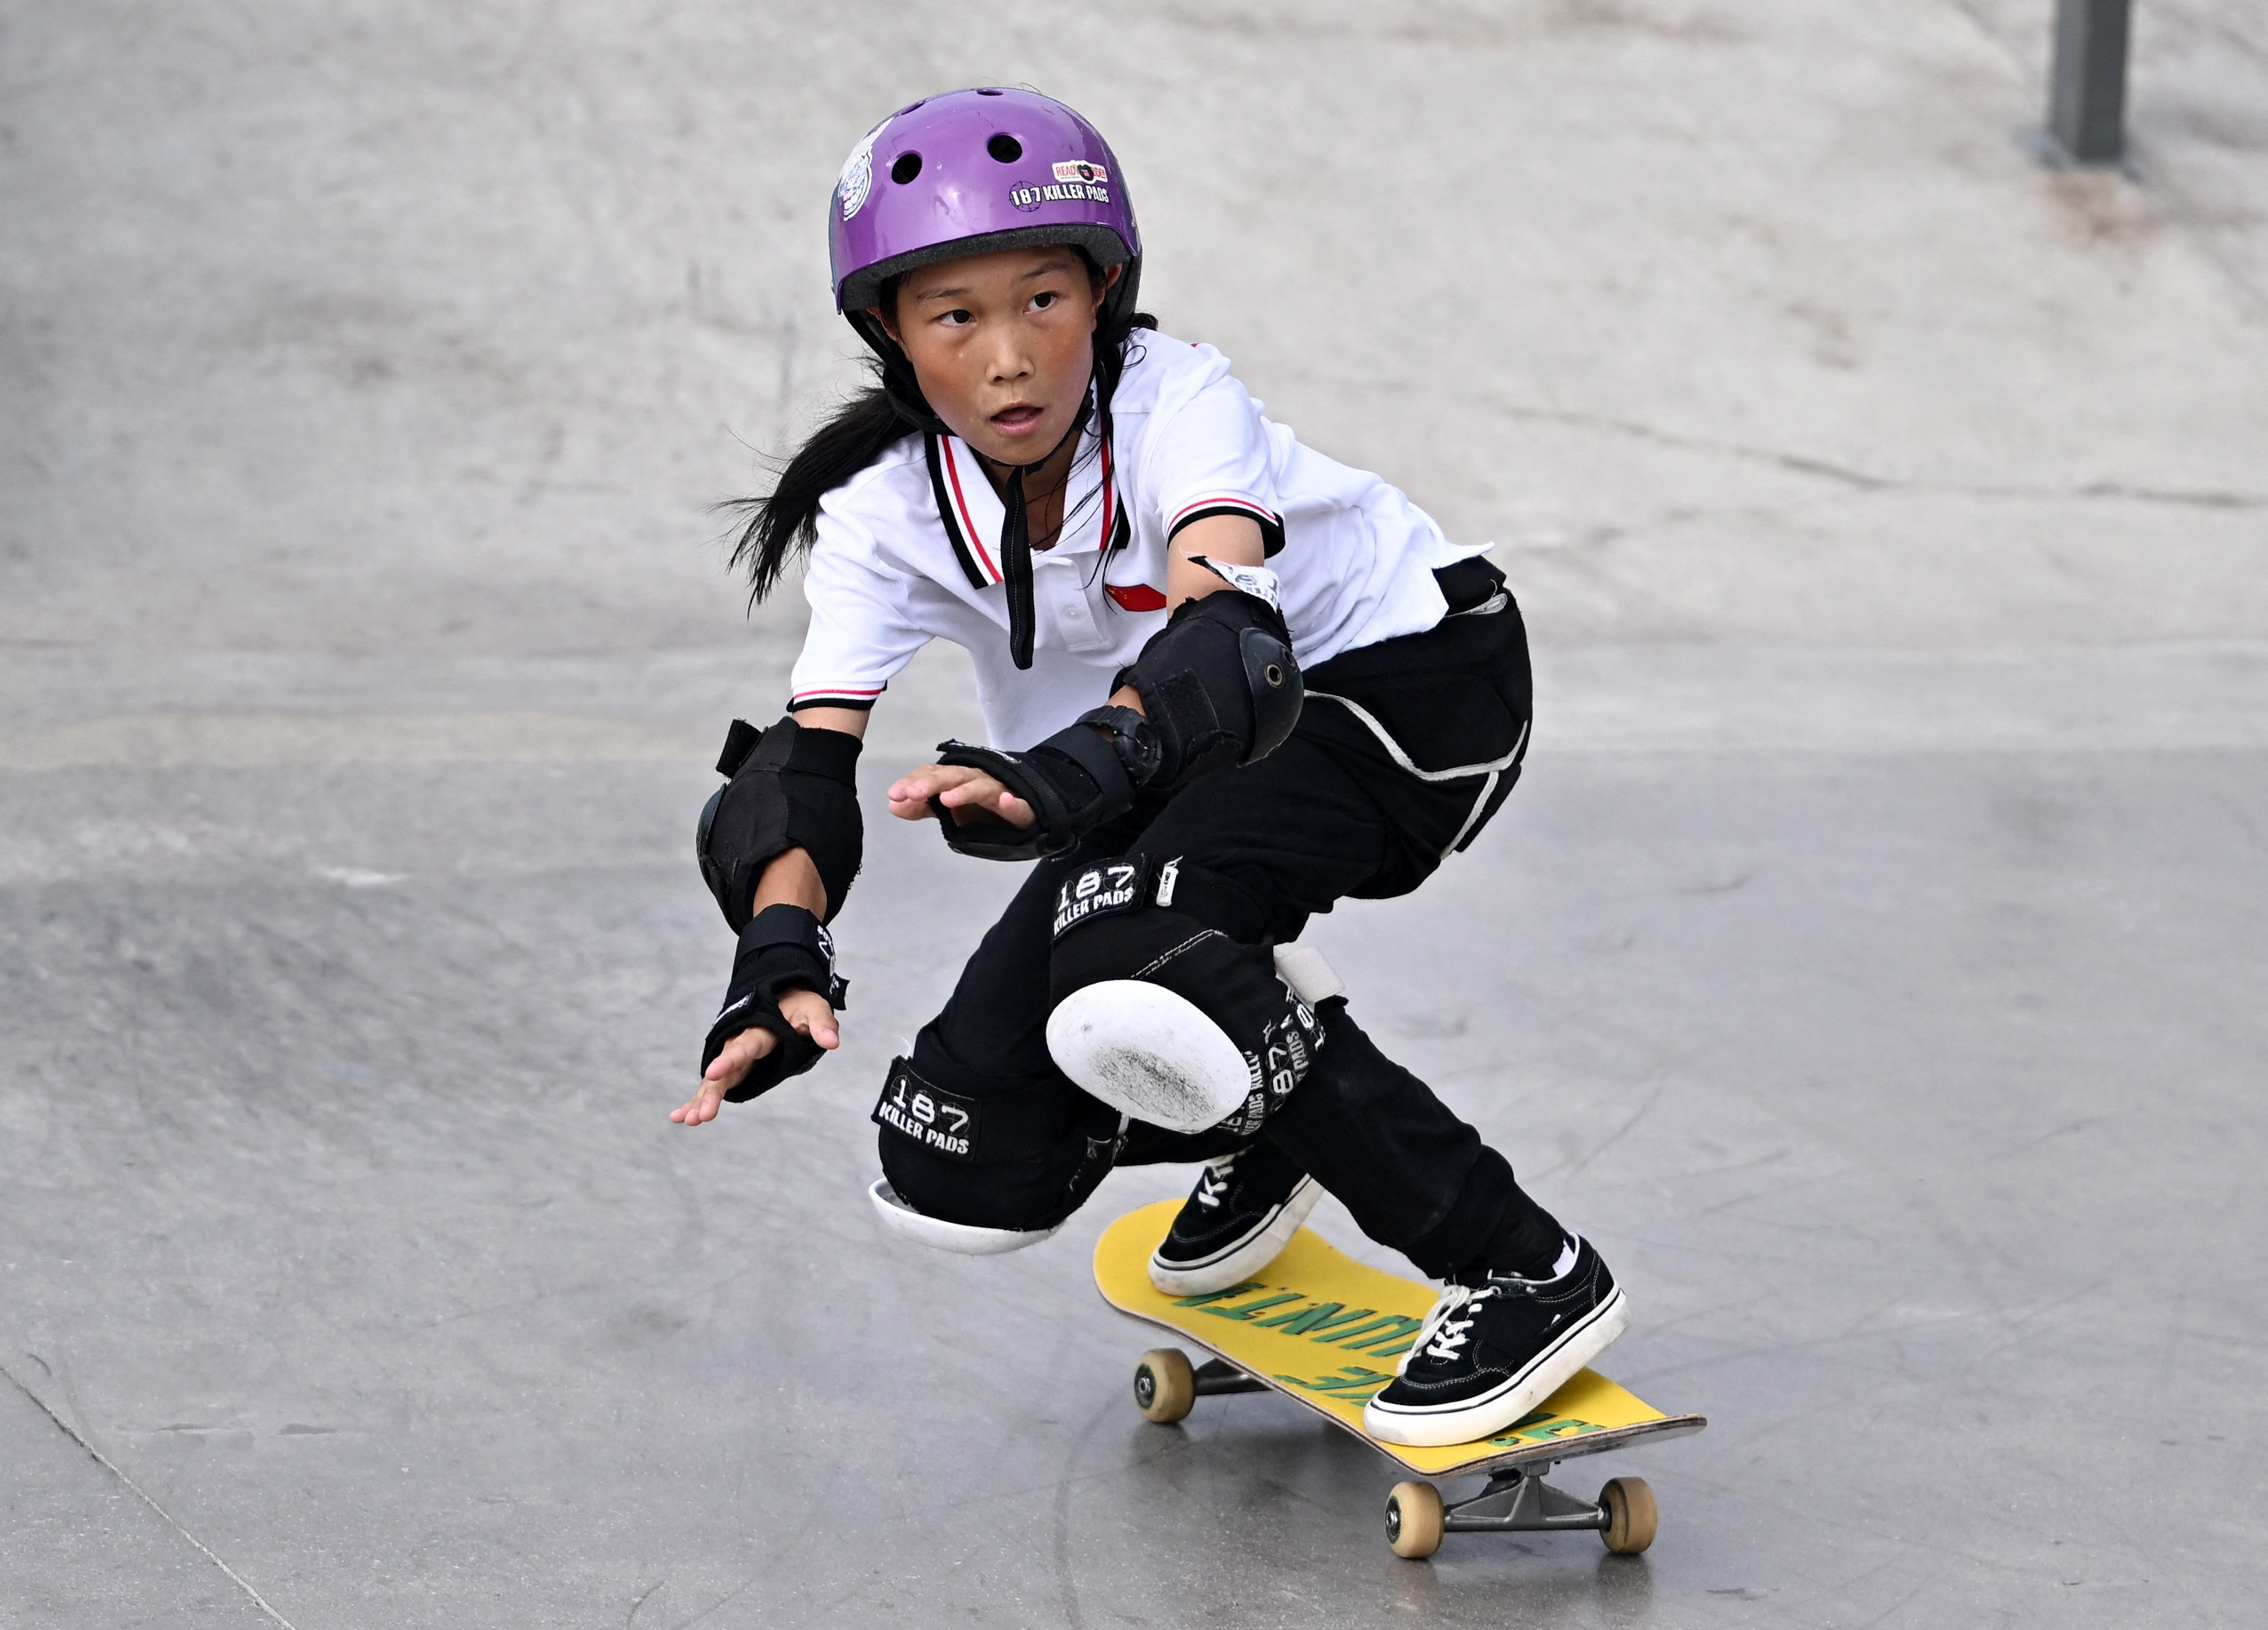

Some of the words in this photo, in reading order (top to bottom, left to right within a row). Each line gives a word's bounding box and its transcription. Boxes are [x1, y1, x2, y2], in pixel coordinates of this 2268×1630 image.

[1011, 187, 1042, 206] 187
[1042, 183, 1085, 201] KILLER
[1085, 184, 1110, 204] PADS
[1053, 899, 1090, 936] KILLER
[1092, 886, 1135, 911] PADS
[1057, 865, 1135, 913] 187
[878, 1100, 925, 1141] KILLER
[925, 1128, 971, 1155] PADS
[893, 1078, 970, 1133] 187
